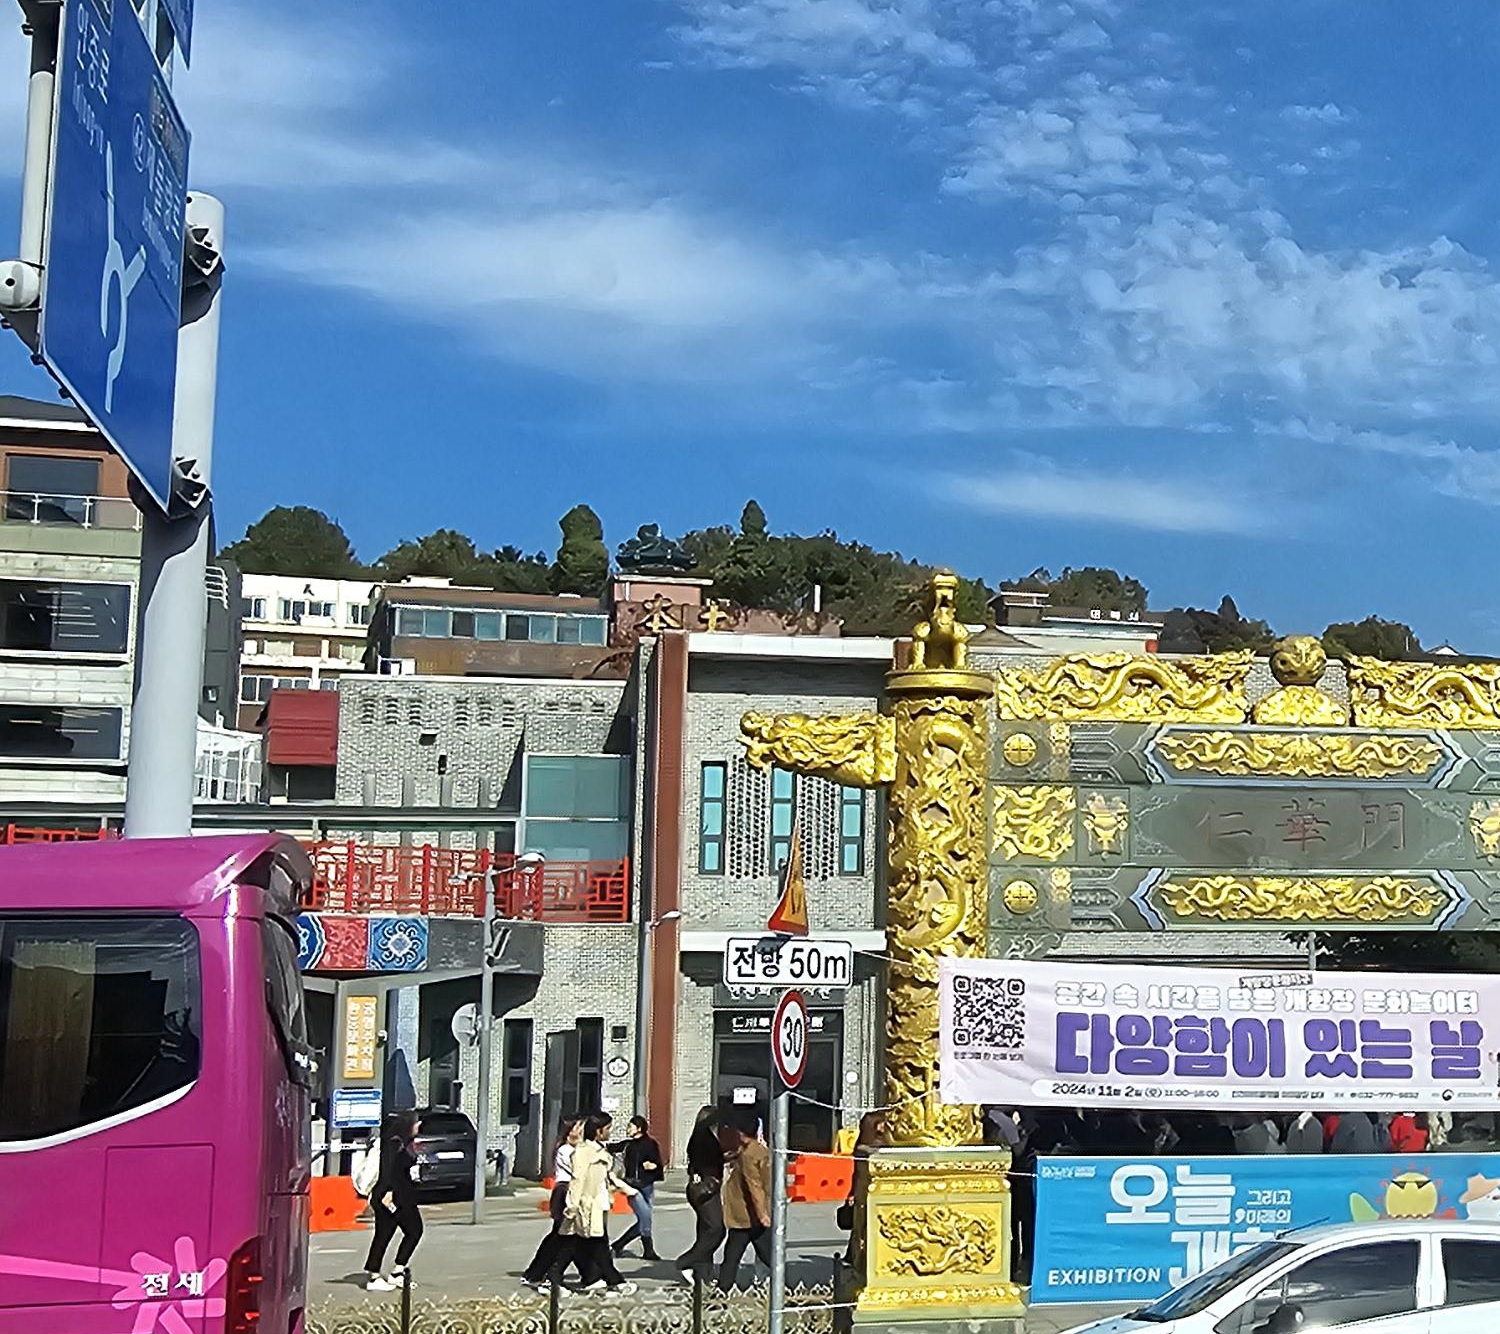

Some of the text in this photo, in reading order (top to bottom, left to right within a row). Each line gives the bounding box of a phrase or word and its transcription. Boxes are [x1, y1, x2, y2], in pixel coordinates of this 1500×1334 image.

[732, 944, 847, 979] 전방 50m
[1055, 980, 1107, 1008] 공간
[1113, 983, 1139, 1009] 속
[1145, 984, 1221, 1011] 시간을
[1283, 988, 1356, 1013] 개항장
[1362, 989, 1479, 1015] 문화놀이터
[782, 1015, 806, 1059] 30
[1055, 1012, 1484, 1080] 다양함이 있는 날
[1246, 1189, 1292, 1206] 그리고
[1246, 1207, 1292, 1224] 미래의
[142, 1271, 205, 1297] 전세
[1048, 1267, 1161, 1286] EXHIBITION
